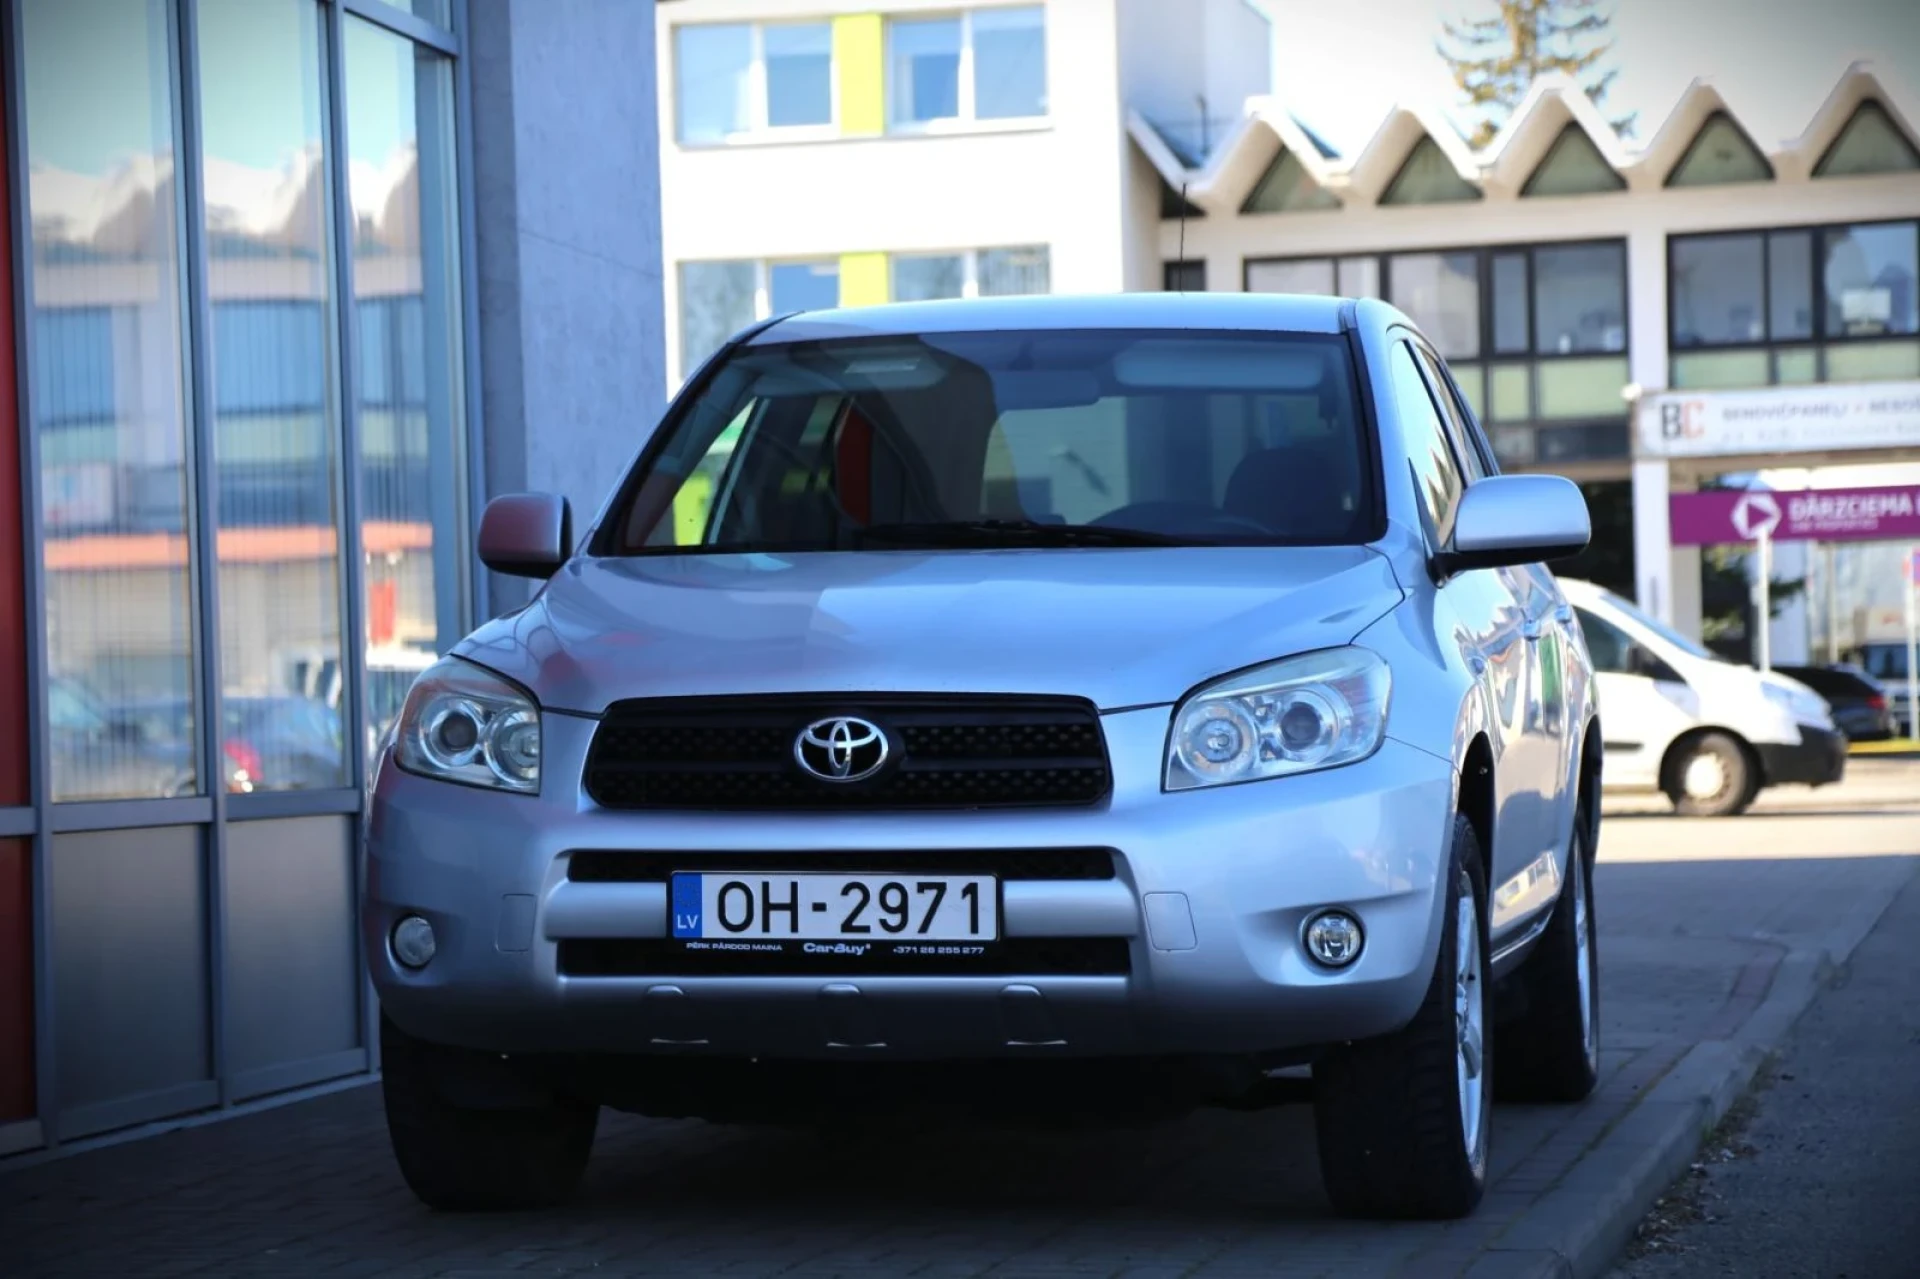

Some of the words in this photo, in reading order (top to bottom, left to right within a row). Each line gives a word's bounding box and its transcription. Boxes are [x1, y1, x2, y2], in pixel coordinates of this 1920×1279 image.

[1661, 402, 1705, 440] BC
[676, 914, 698, 929] LV
[717, 881, 979, 934] OH-2971
